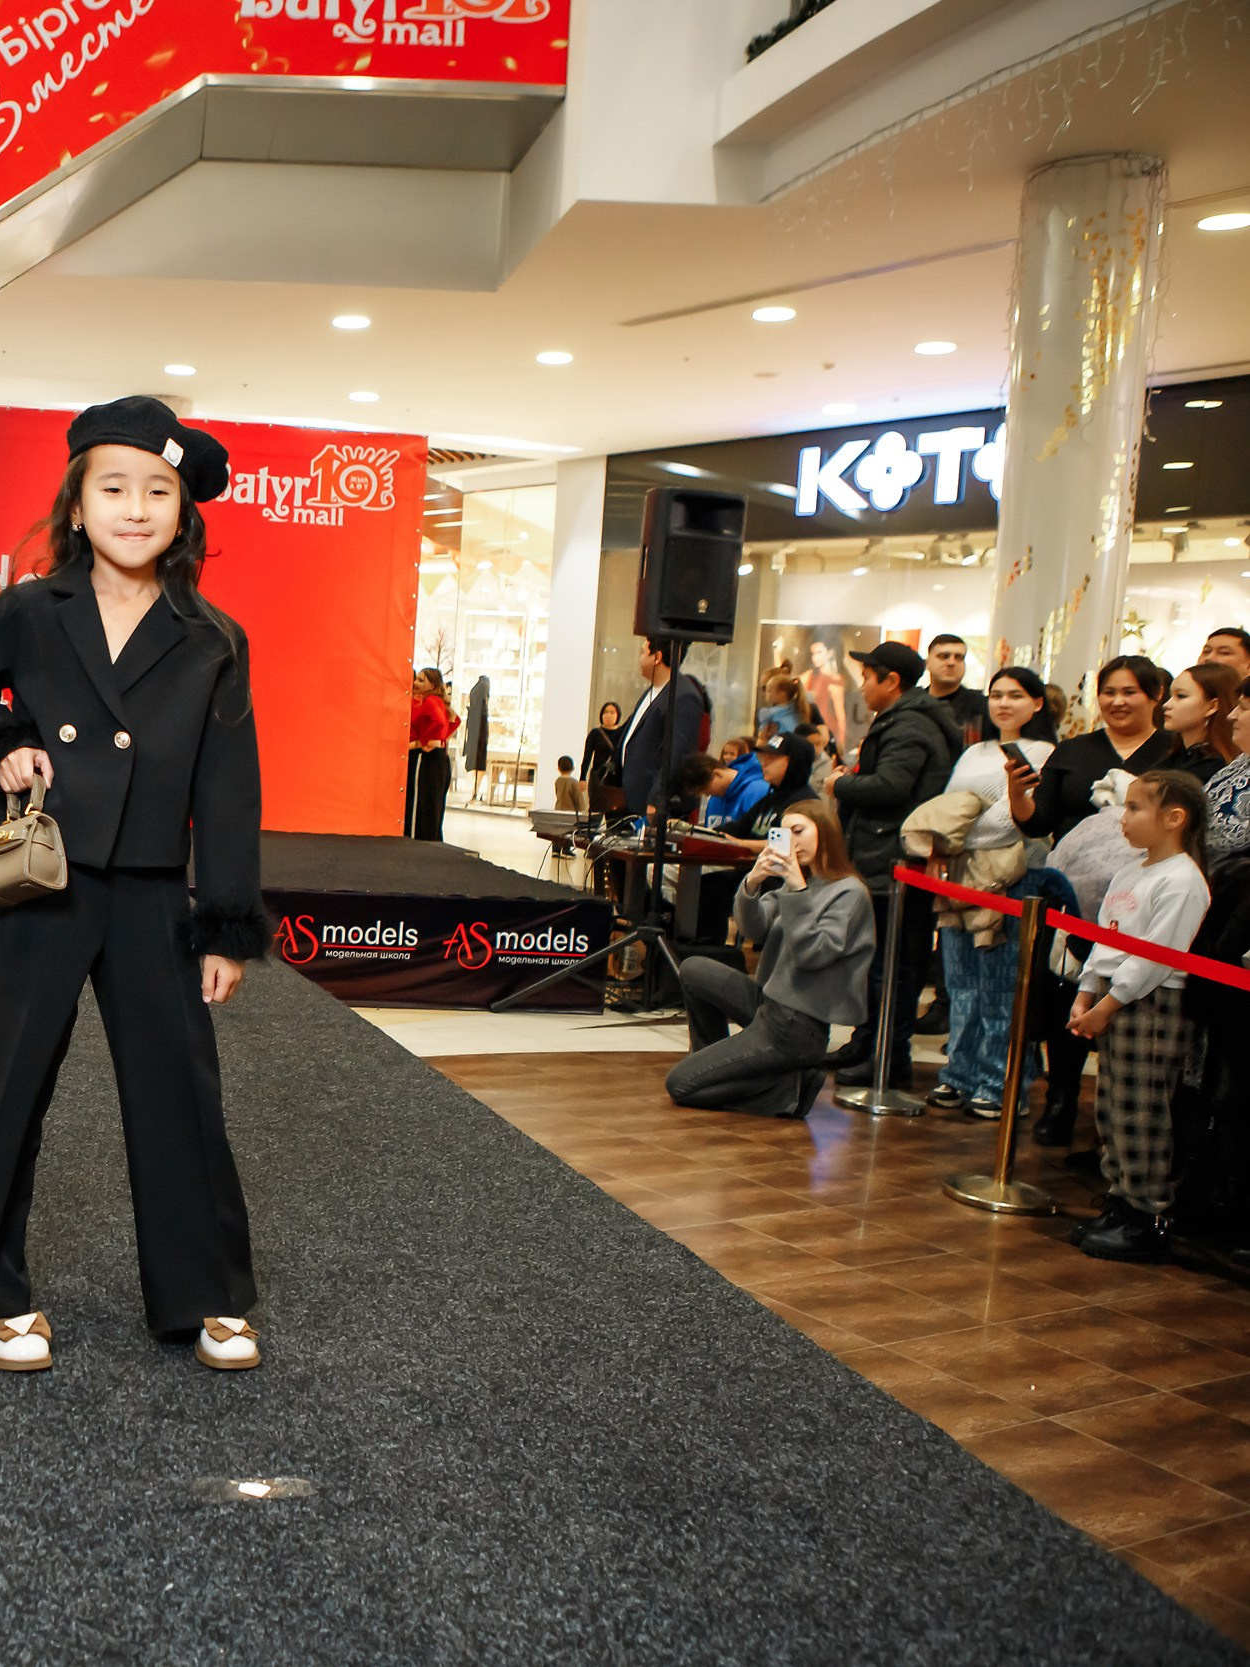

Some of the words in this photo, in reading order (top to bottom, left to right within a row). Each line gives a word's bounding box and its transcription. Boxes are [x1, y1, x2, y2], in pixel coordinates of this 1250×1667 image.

[381, 20, 465, 46] mall
[292, 508, 344, 526] mall
[272, 914, 319, 964] AS
[322, 920, 419, 947] models
[442, 921, 492, 970] AS
[495, 926, 589, 953] models
[325, 950, 378, 960] модельная
[498, 956, 550, 965] модельная
